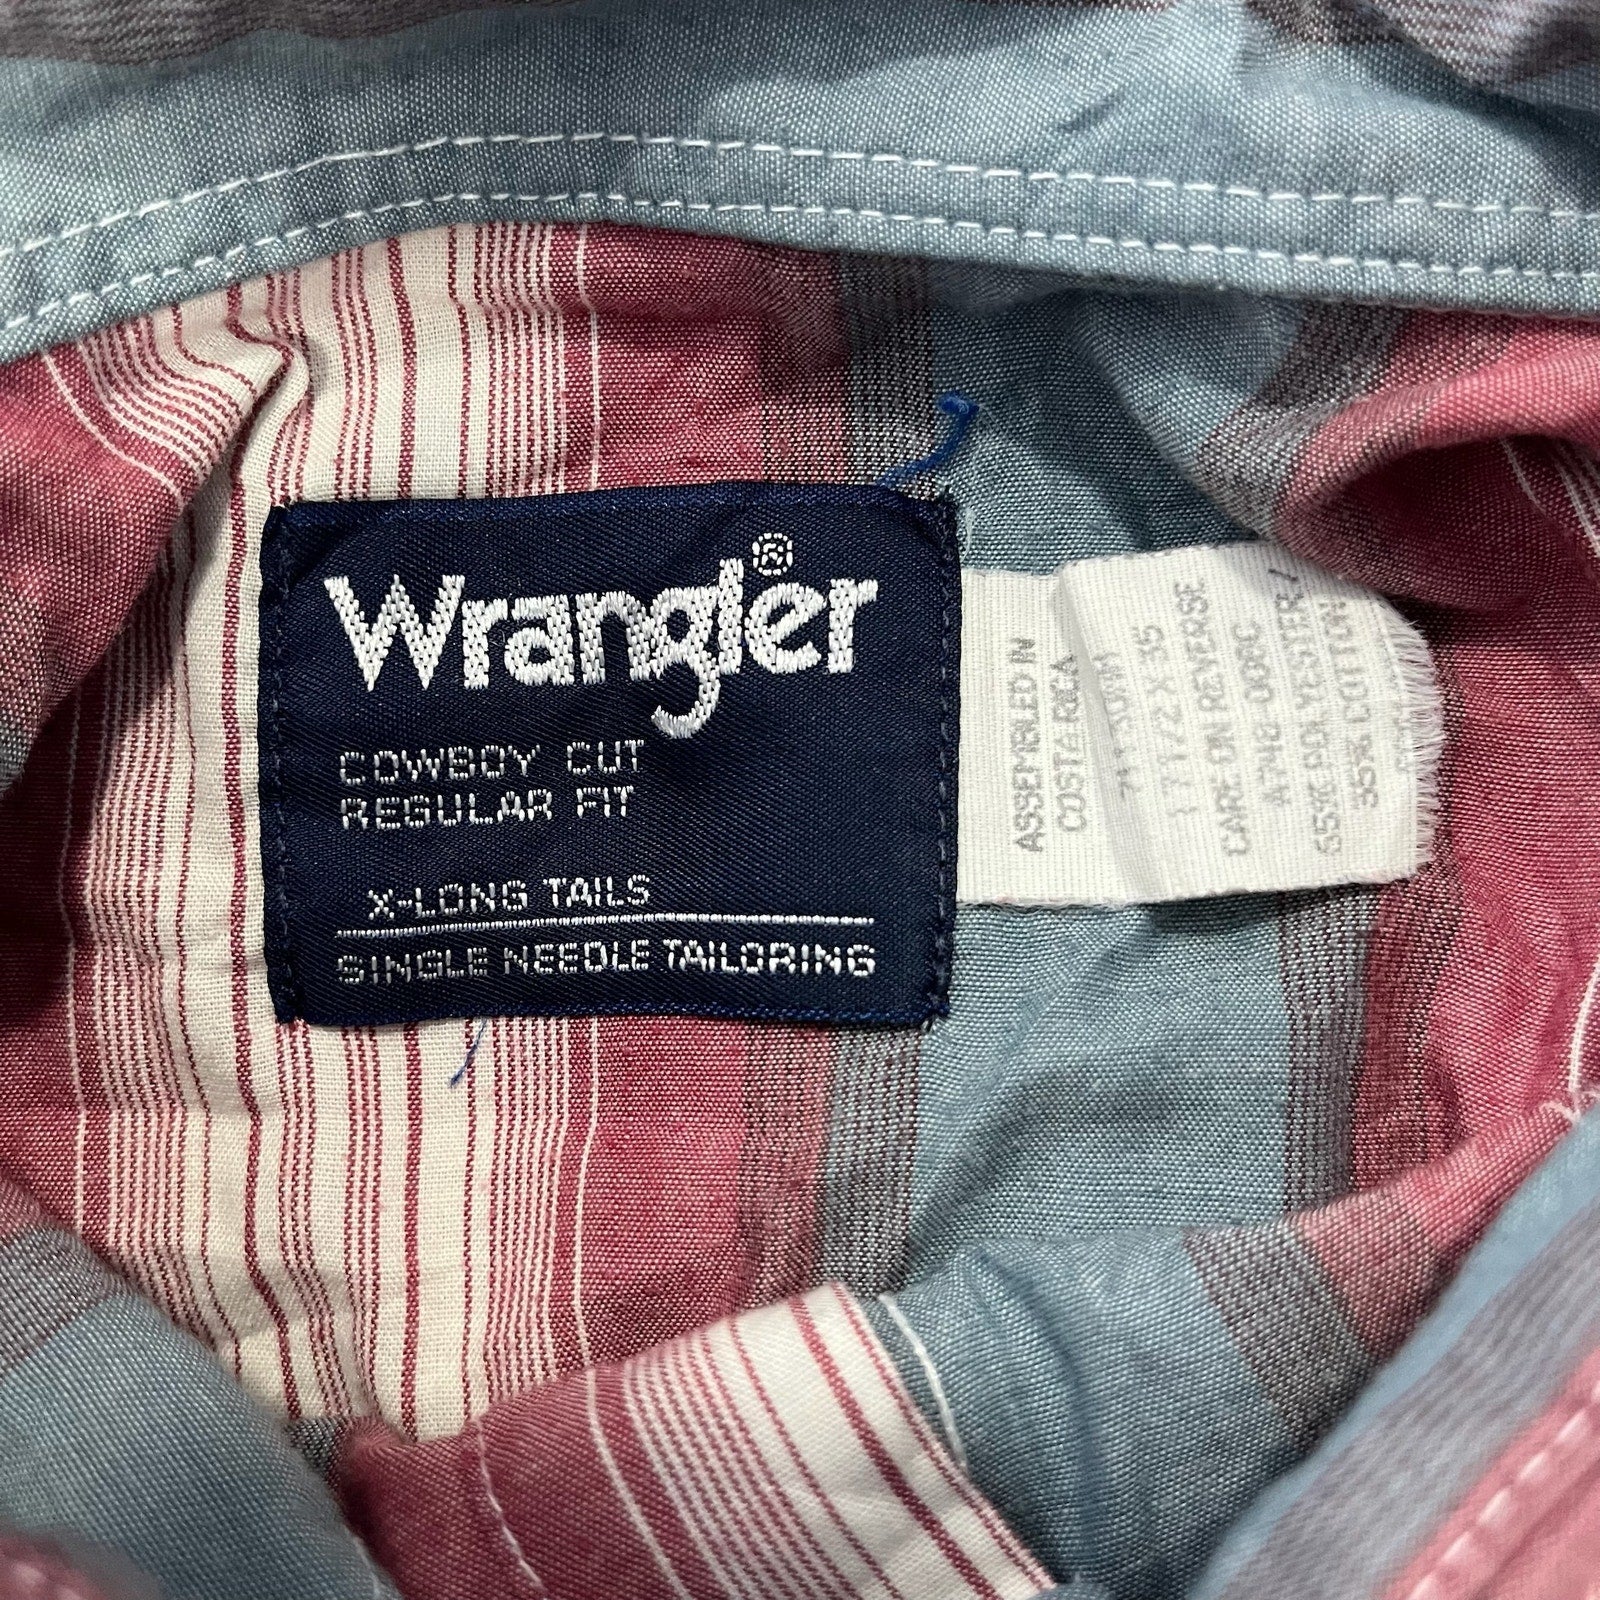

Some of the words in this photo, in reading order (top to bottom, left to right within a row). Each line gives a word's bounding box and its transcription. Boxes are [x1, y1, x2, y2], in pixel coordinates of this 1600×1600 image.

[324, 558, 878, 738] Wrangler
[1010, 637, 1036, 664] IN
[1130, 625, 1166, 666] 35
[1174, 580, 1226, 716] REVERSE
[1315, 600, 1372, 724] COTTON
[1050, 654, 1080, 723] RICA
[1276, 593, 1334, 770] POLYESTER
[338, 744, 540, 786] COWBOY
[566, 739, 645, 776] CUT
[1010, 672, 1044, 853] ASSEMBLED
[1203, 724, 1237, 767] ON
[340, 788, 553, 830] REGULAR
[576, 785, 635, 819] FIT
[1053, 734, 1087, 833] COSTA
[1214, 777, 1252, 858] CARE
[367, 879, 528, 920] X-LONG
[543, 874, 651, 908] TAILS
[337, 946, 489, 985] SINGLE
[503, 938, 650, 975] NEEDLE
[662, 938, 876, 977] TAILORING
